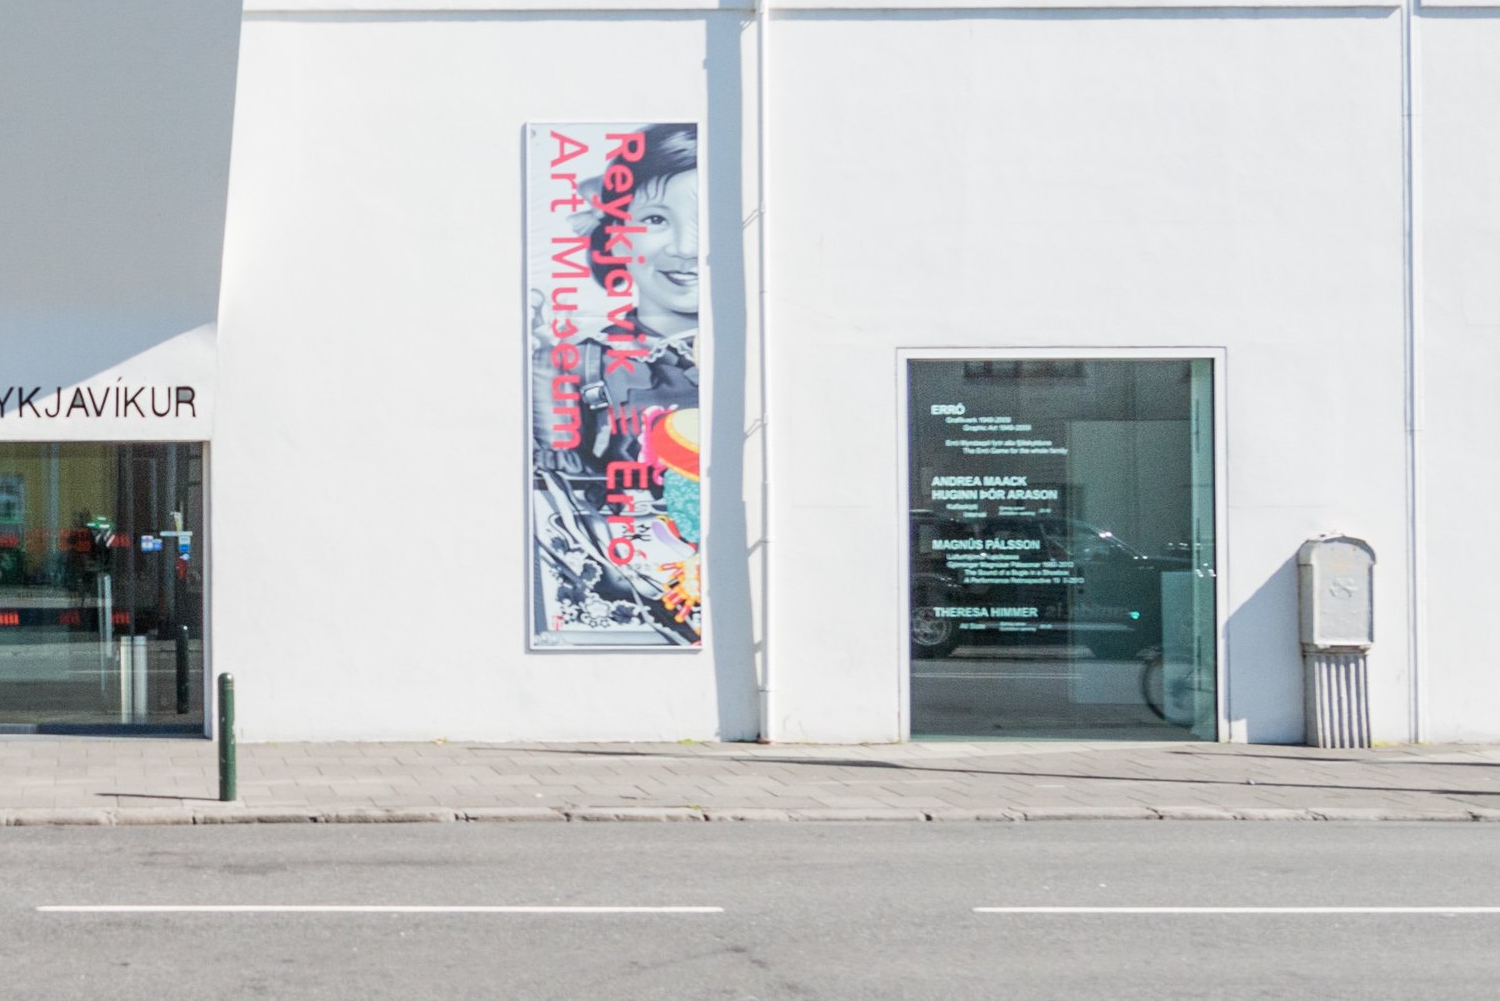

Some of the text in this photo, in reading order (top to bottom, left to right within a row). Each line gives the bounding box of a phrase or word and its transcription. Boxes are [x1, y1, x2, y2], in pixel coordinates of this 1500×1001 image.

[592, 132, 649, 375] Reykjavik
[550, 130, 591, 449] Art Museum
[930, 403, 966, 415] ERRÓ
[931, 476, 1028, 486] ANDREA MAACK
[931, 489, 978, 500] HUGINN
[1007, 489, 1058, 500] ARASON
[931, 537, 1041, 550] MAGNÚS PÁLSSON
[933, 607, 989, 617] THERESA
[990, 607, 1039, 617] HIMMER
